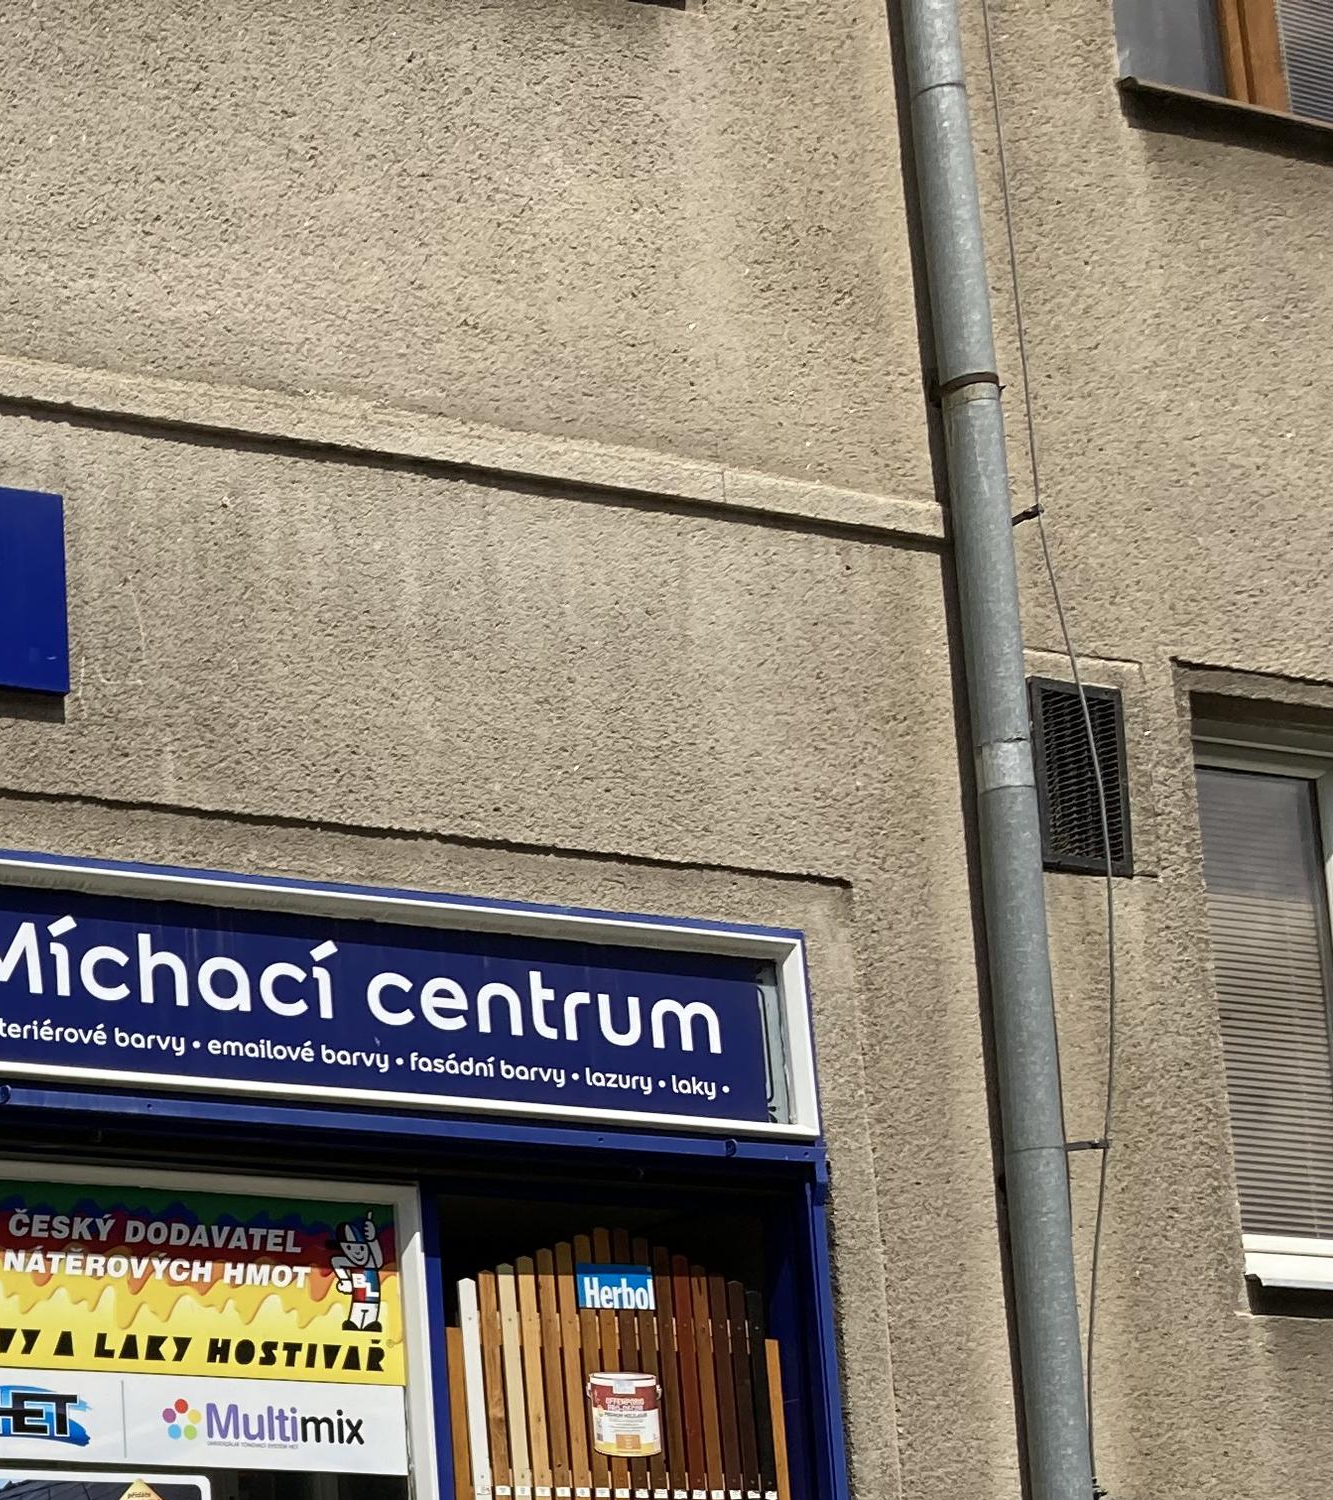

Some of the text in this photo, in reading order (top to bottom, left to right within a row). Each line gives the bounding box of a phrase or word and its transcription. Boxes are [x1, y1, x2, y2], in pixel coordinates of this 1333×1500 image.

[368, 967, 723, 1056] centrum
[114, 1028, 188, 1059] barvy
[208, 1035, 314, 1064] emailové
[321, 1045, 390, 1075] barvy
[409, 1048, 495, 1081] fasádní
[501, 1060, 567, 1089] barvy
[585, 1066, 653, 1096] lazury
[672, 1077, 717, 1102] laky
[8, 1208, 303, 1254] ČESKÝ DODAVATEL
[2, 1246, 311, 1289] NÁTĚROVÝCH HMOT
[583, 1276, 655, 1311] Herbol
[53, 1330, 75, 1358] A
[94, 1332, 193, 1364] LAKY
[207, 1338, 385, 1373] HOSTIVAŘ
[205, 1402, 365, 1445] Multimix
